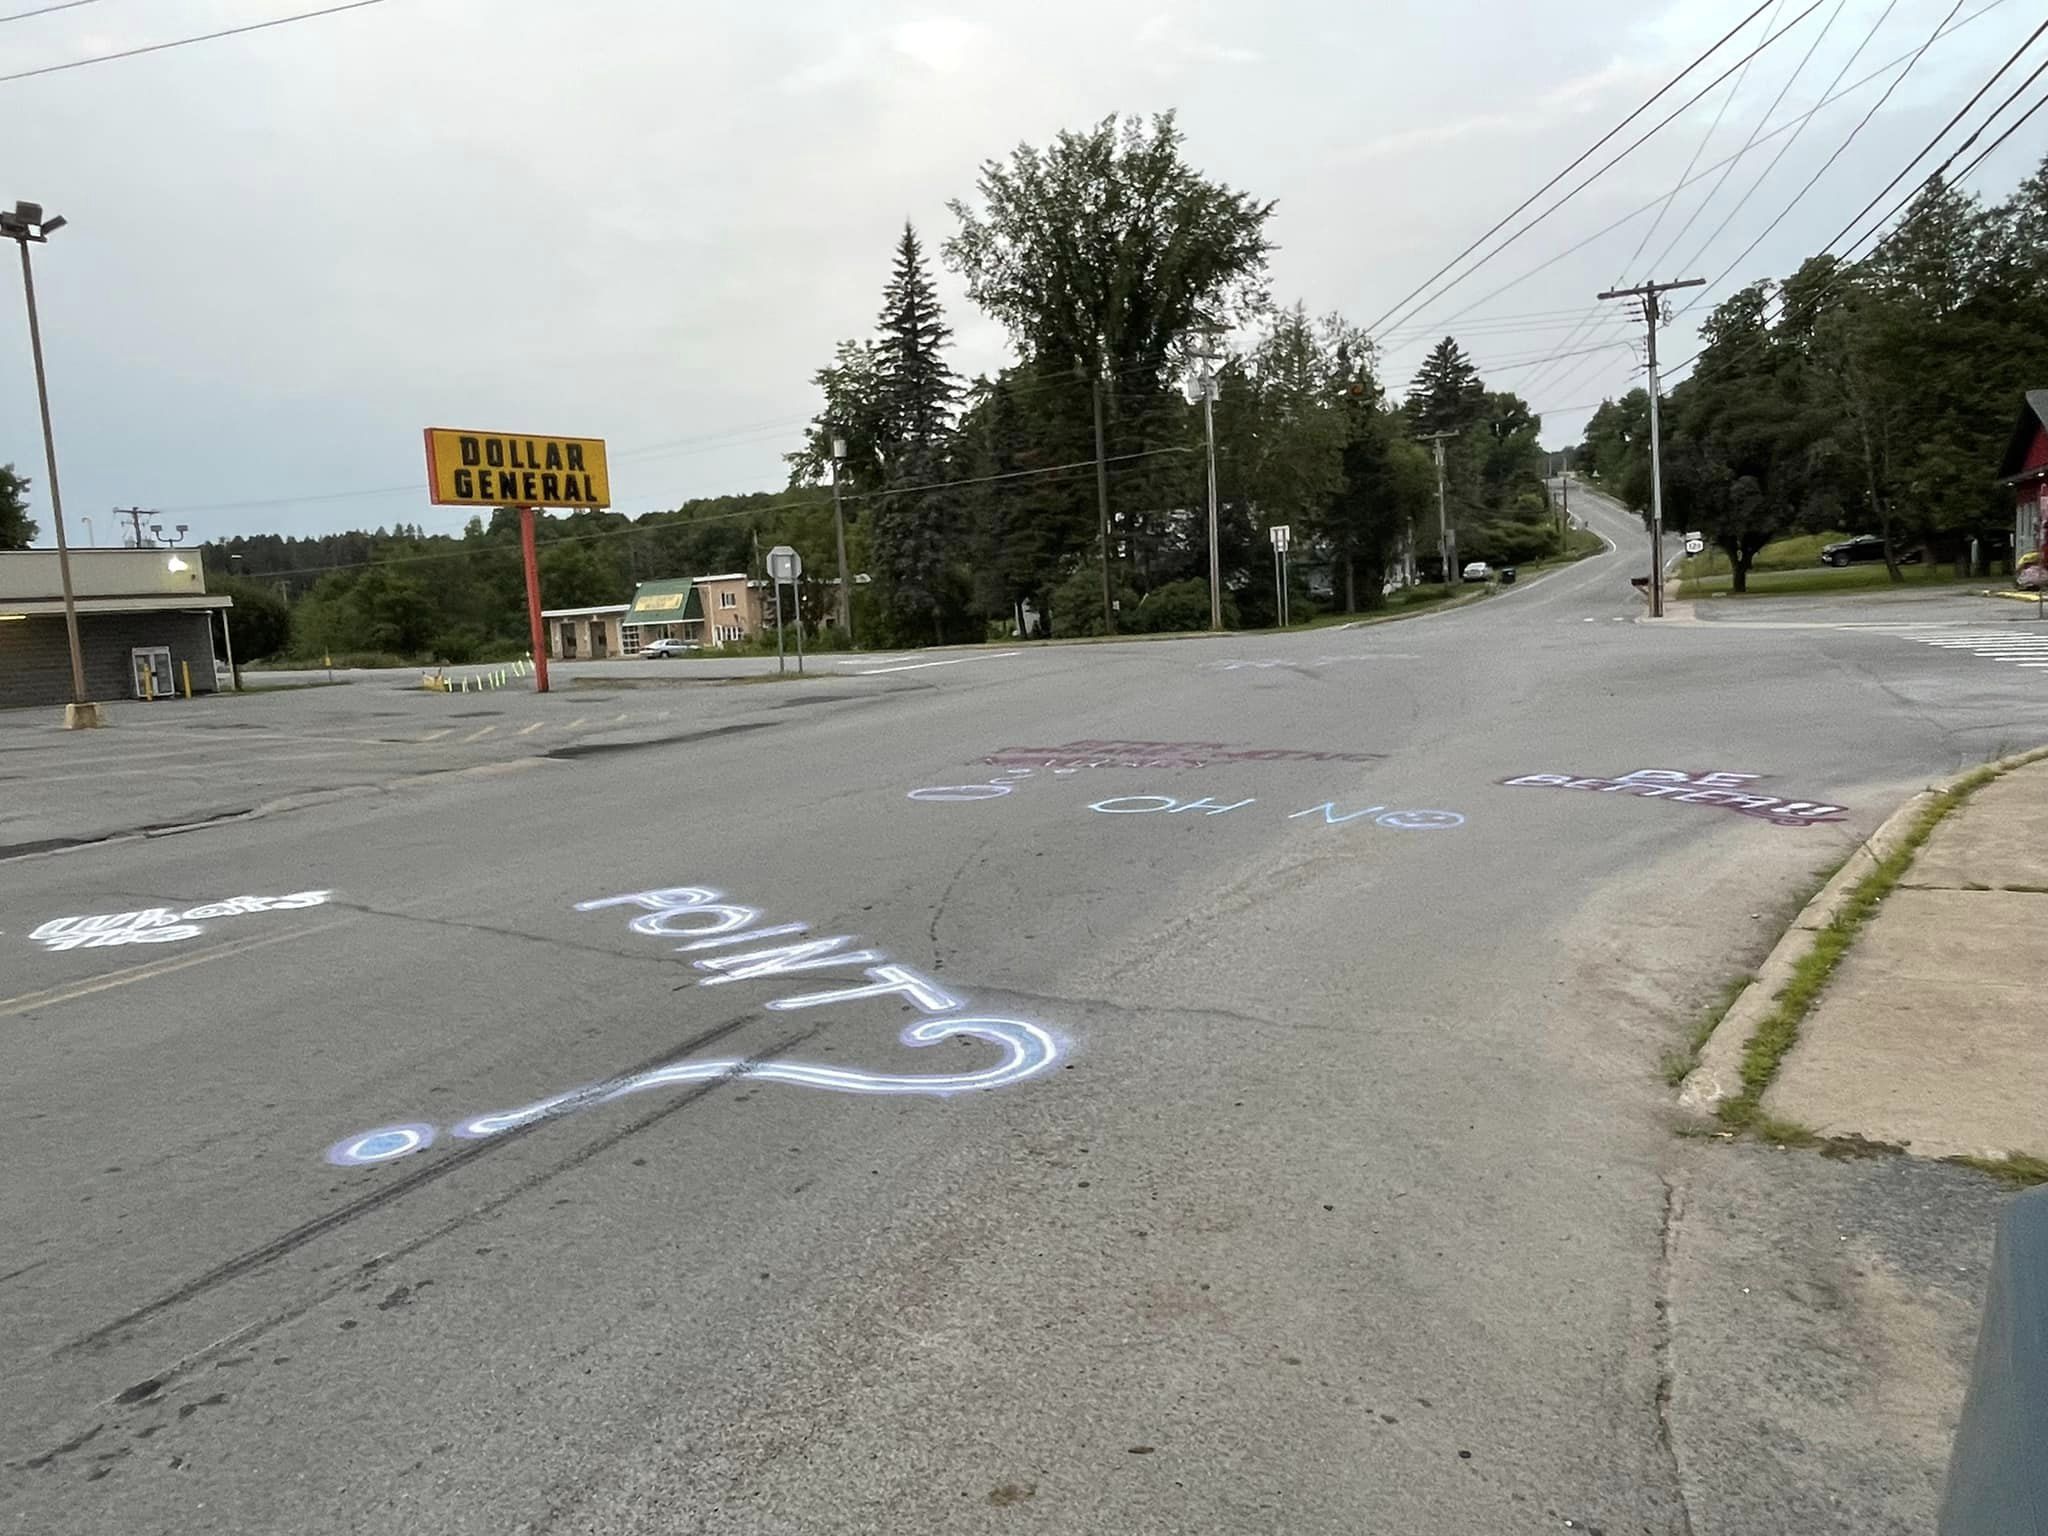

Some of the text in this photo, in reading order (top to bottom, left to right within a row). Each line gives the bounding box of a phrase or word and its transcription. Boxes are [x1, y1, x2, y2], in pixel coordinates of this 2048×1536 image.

[459, 436, 585, 472] DOLLAR
[454, 468, 598, 502] GENERAL
[1087, 795, 1257, 816] OH
[572, 885, 963, 1013] POINT
